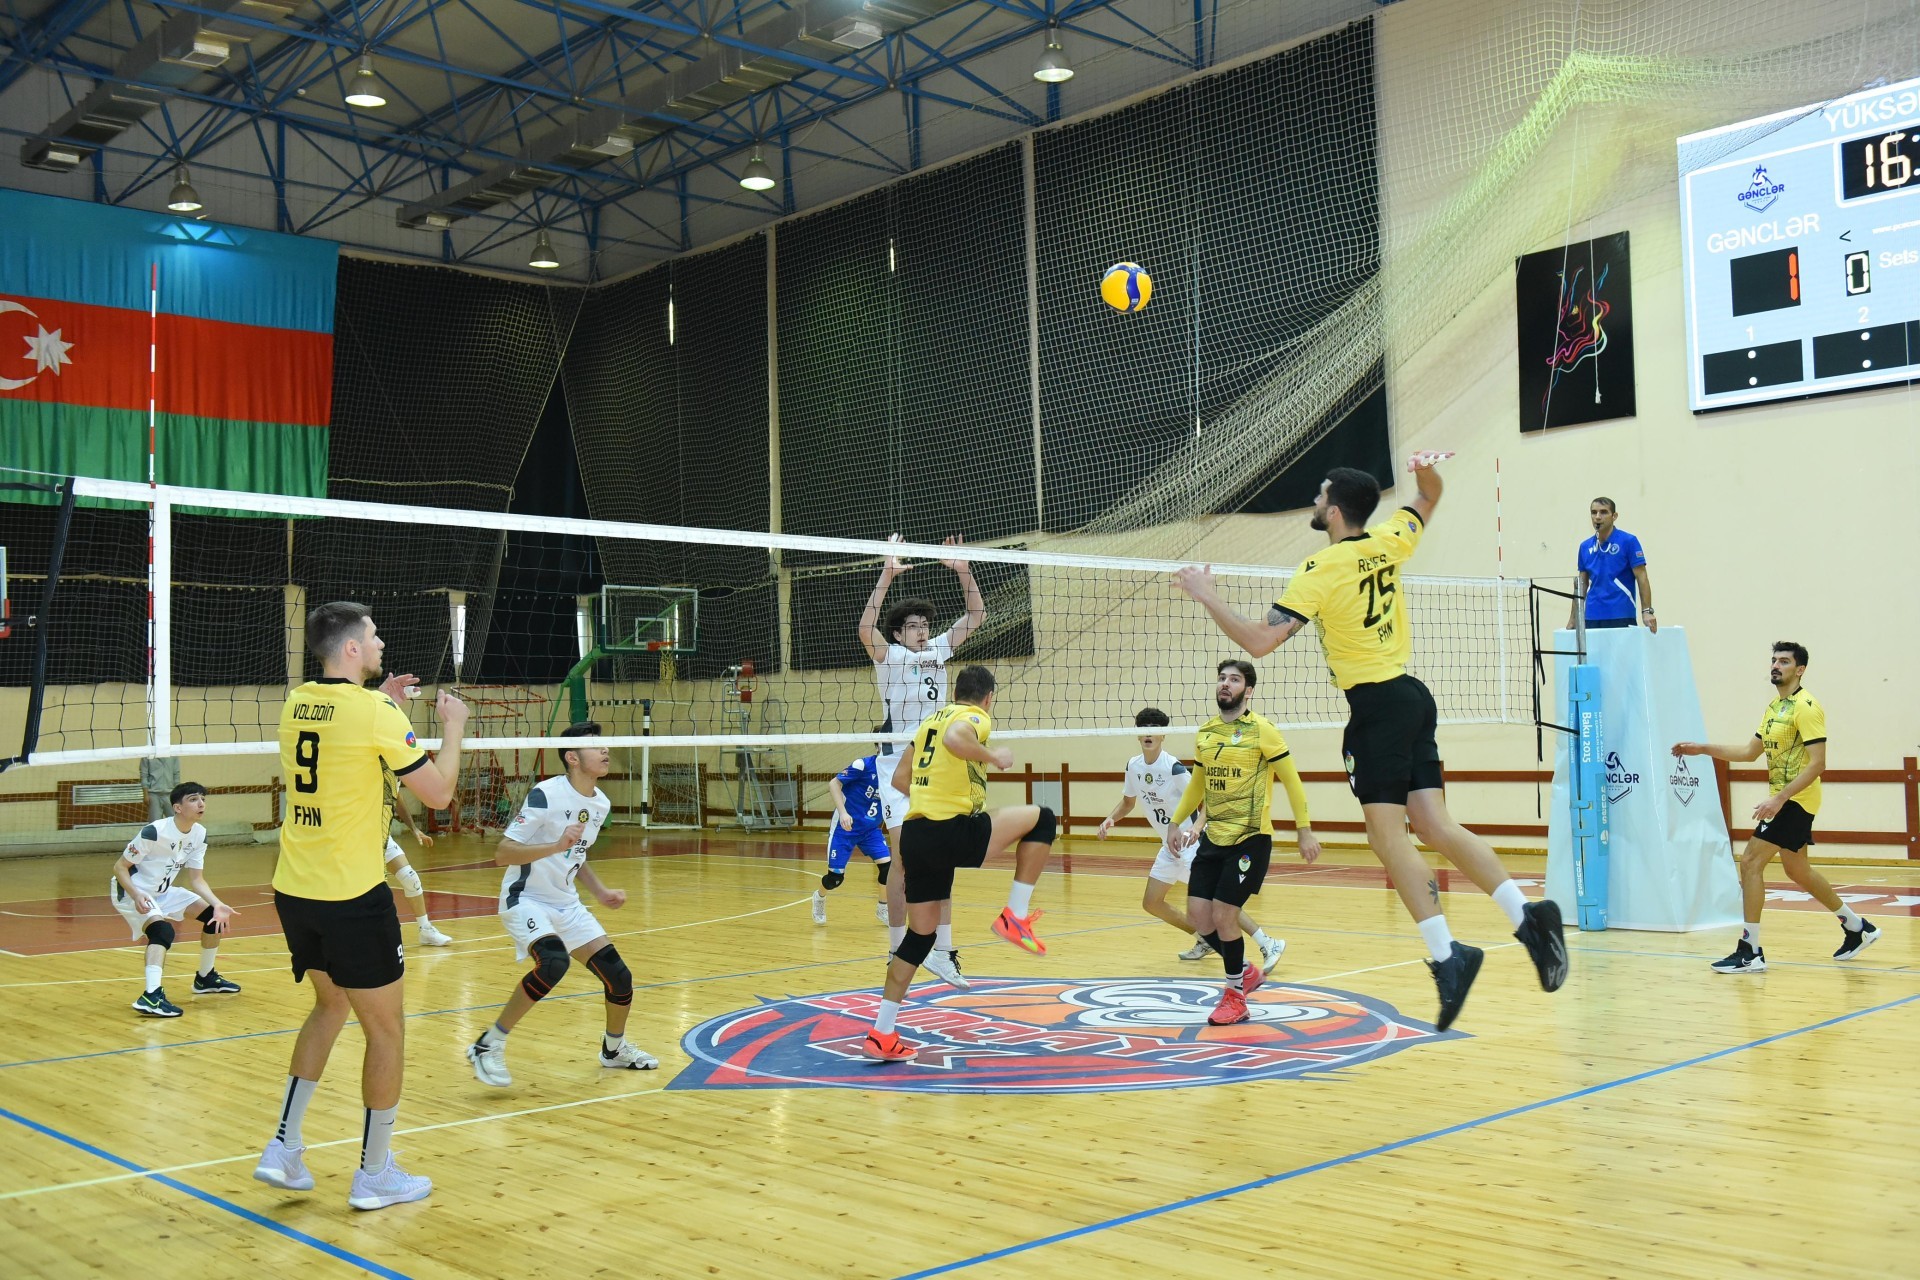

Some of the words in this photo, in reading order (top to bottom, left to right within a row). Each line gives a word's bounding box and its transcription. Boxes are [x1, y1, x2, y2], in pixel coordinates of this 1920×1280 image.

[1823, 87, 1920, 133] YÜKSƏ
[1737, 183, 1785, 202] GƏNCLƏR
[1706, 213, 1821, 254] GƏNCLƏR
[1878, 249, 1919, 269] Sets
[1788, 253, 1799, 301] 1
[1846, 252, 1870, 295] 0
[1857, 306, 1870, 324] 2
[1745, 325, 1755, 342] 1
[1359, 564, 1396, 629] 25
[924, 676, 939, 701] 3
[1582, 712, 1593, 738] Baku
[918, 728, 938, 769] 5
[1214, 742, 1225, 761] 7
[1583, 740, 1591, 763] 2015
[295, 730, 321, 794] 9
[1231, 767, 1242, 778] VK
[1606, 773, 1640, 784] NCLƏR
[1669, 775, 1700, 788] GƏNCLƏR
[1209, 778, 1226, 791] FHN
[294, 804, 322, 827] FHN
[867, 802, 879, 818] 5
[884, 804, 892, 817] 3
[831, 849, 837, 859] 5
[527, 917, 536, 930] 6
